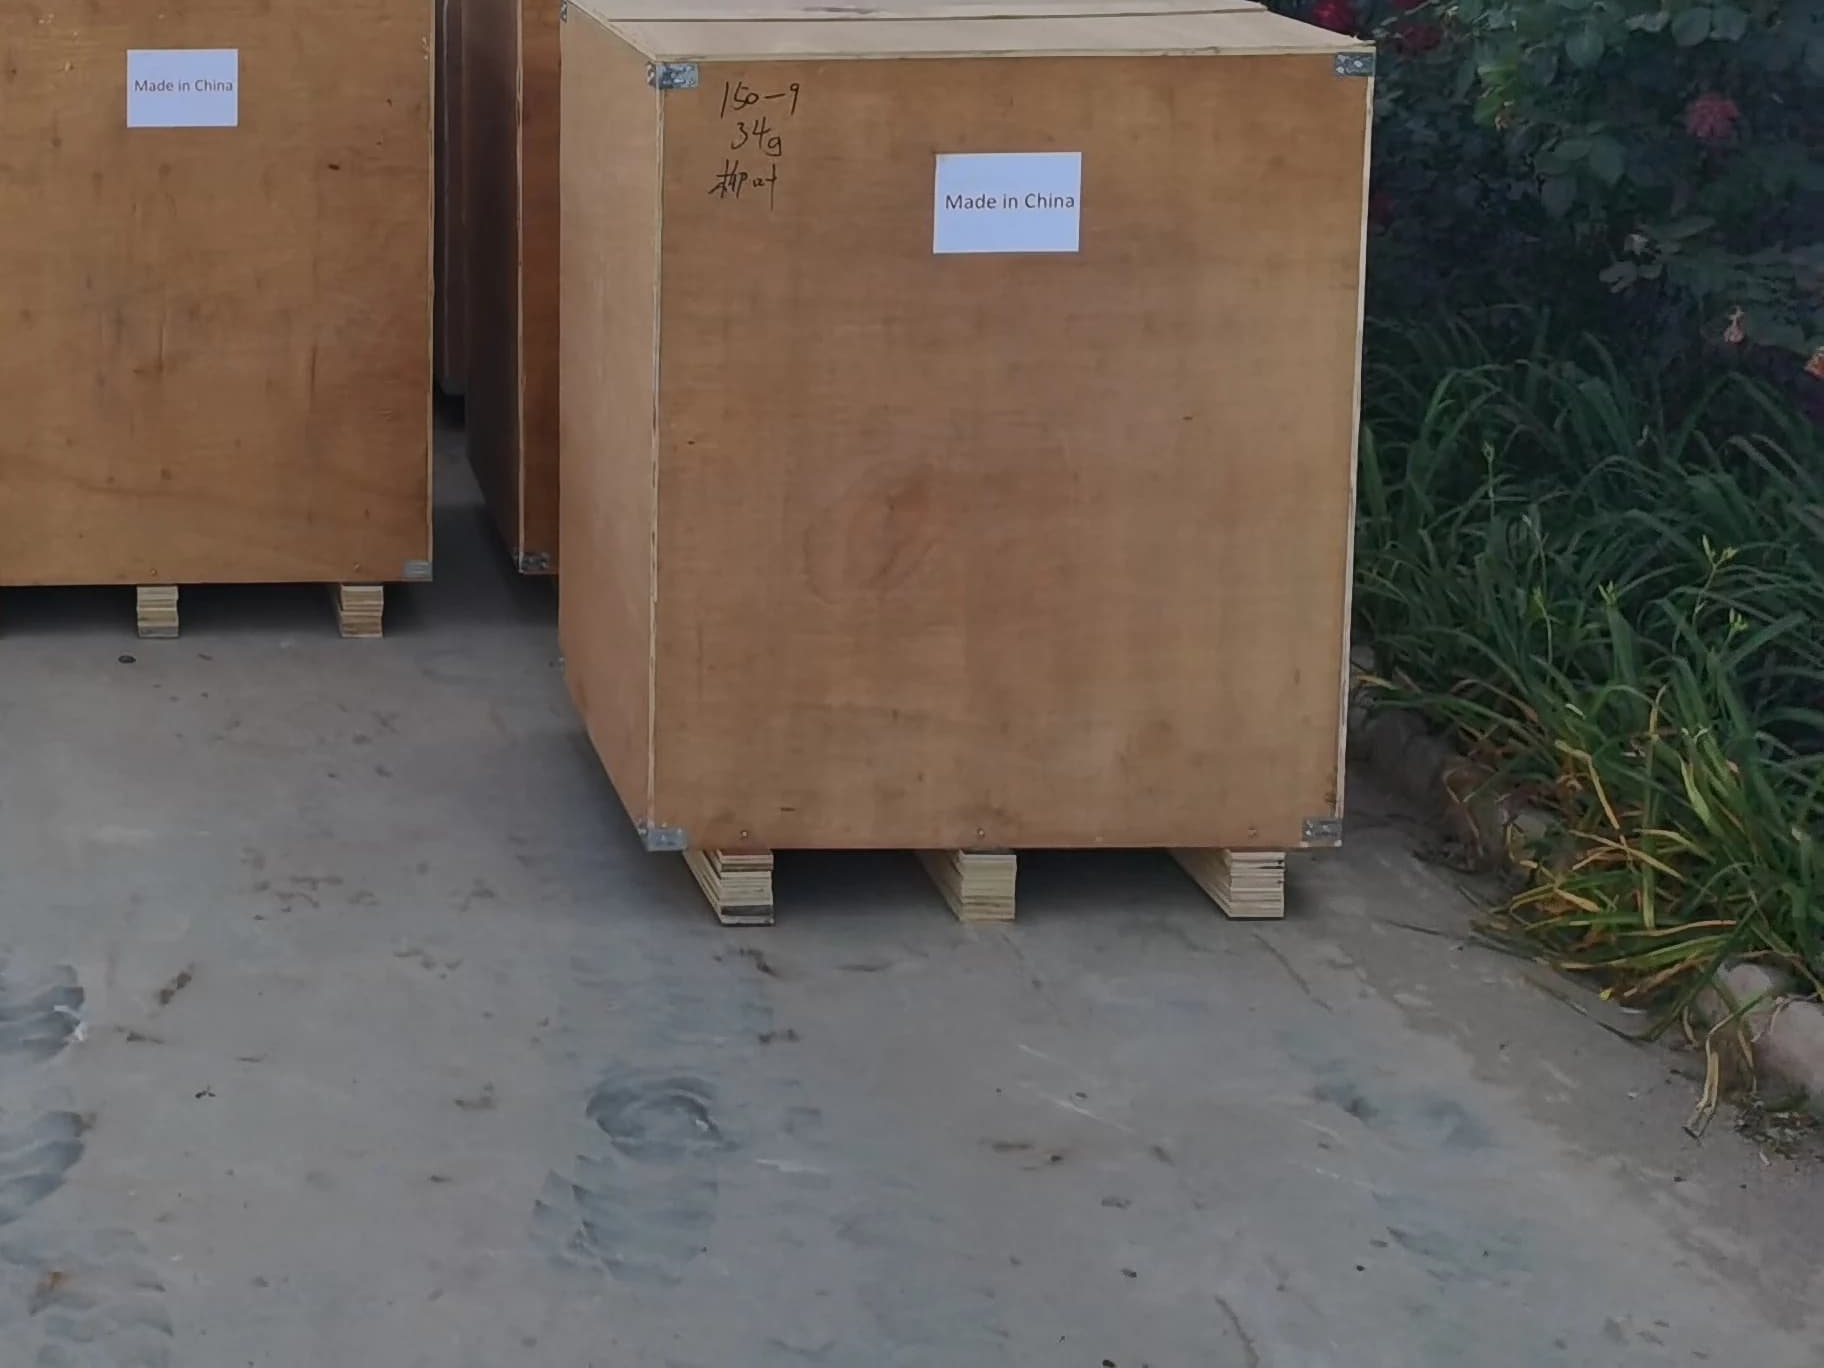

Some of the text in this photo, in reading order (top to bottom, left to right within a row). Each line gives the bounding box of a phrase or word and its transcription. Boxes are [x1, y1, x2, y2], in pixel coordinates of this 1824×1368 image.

[133, 79, 233, 92] Made in China
[945, 192, 1075, 210] Made in China
